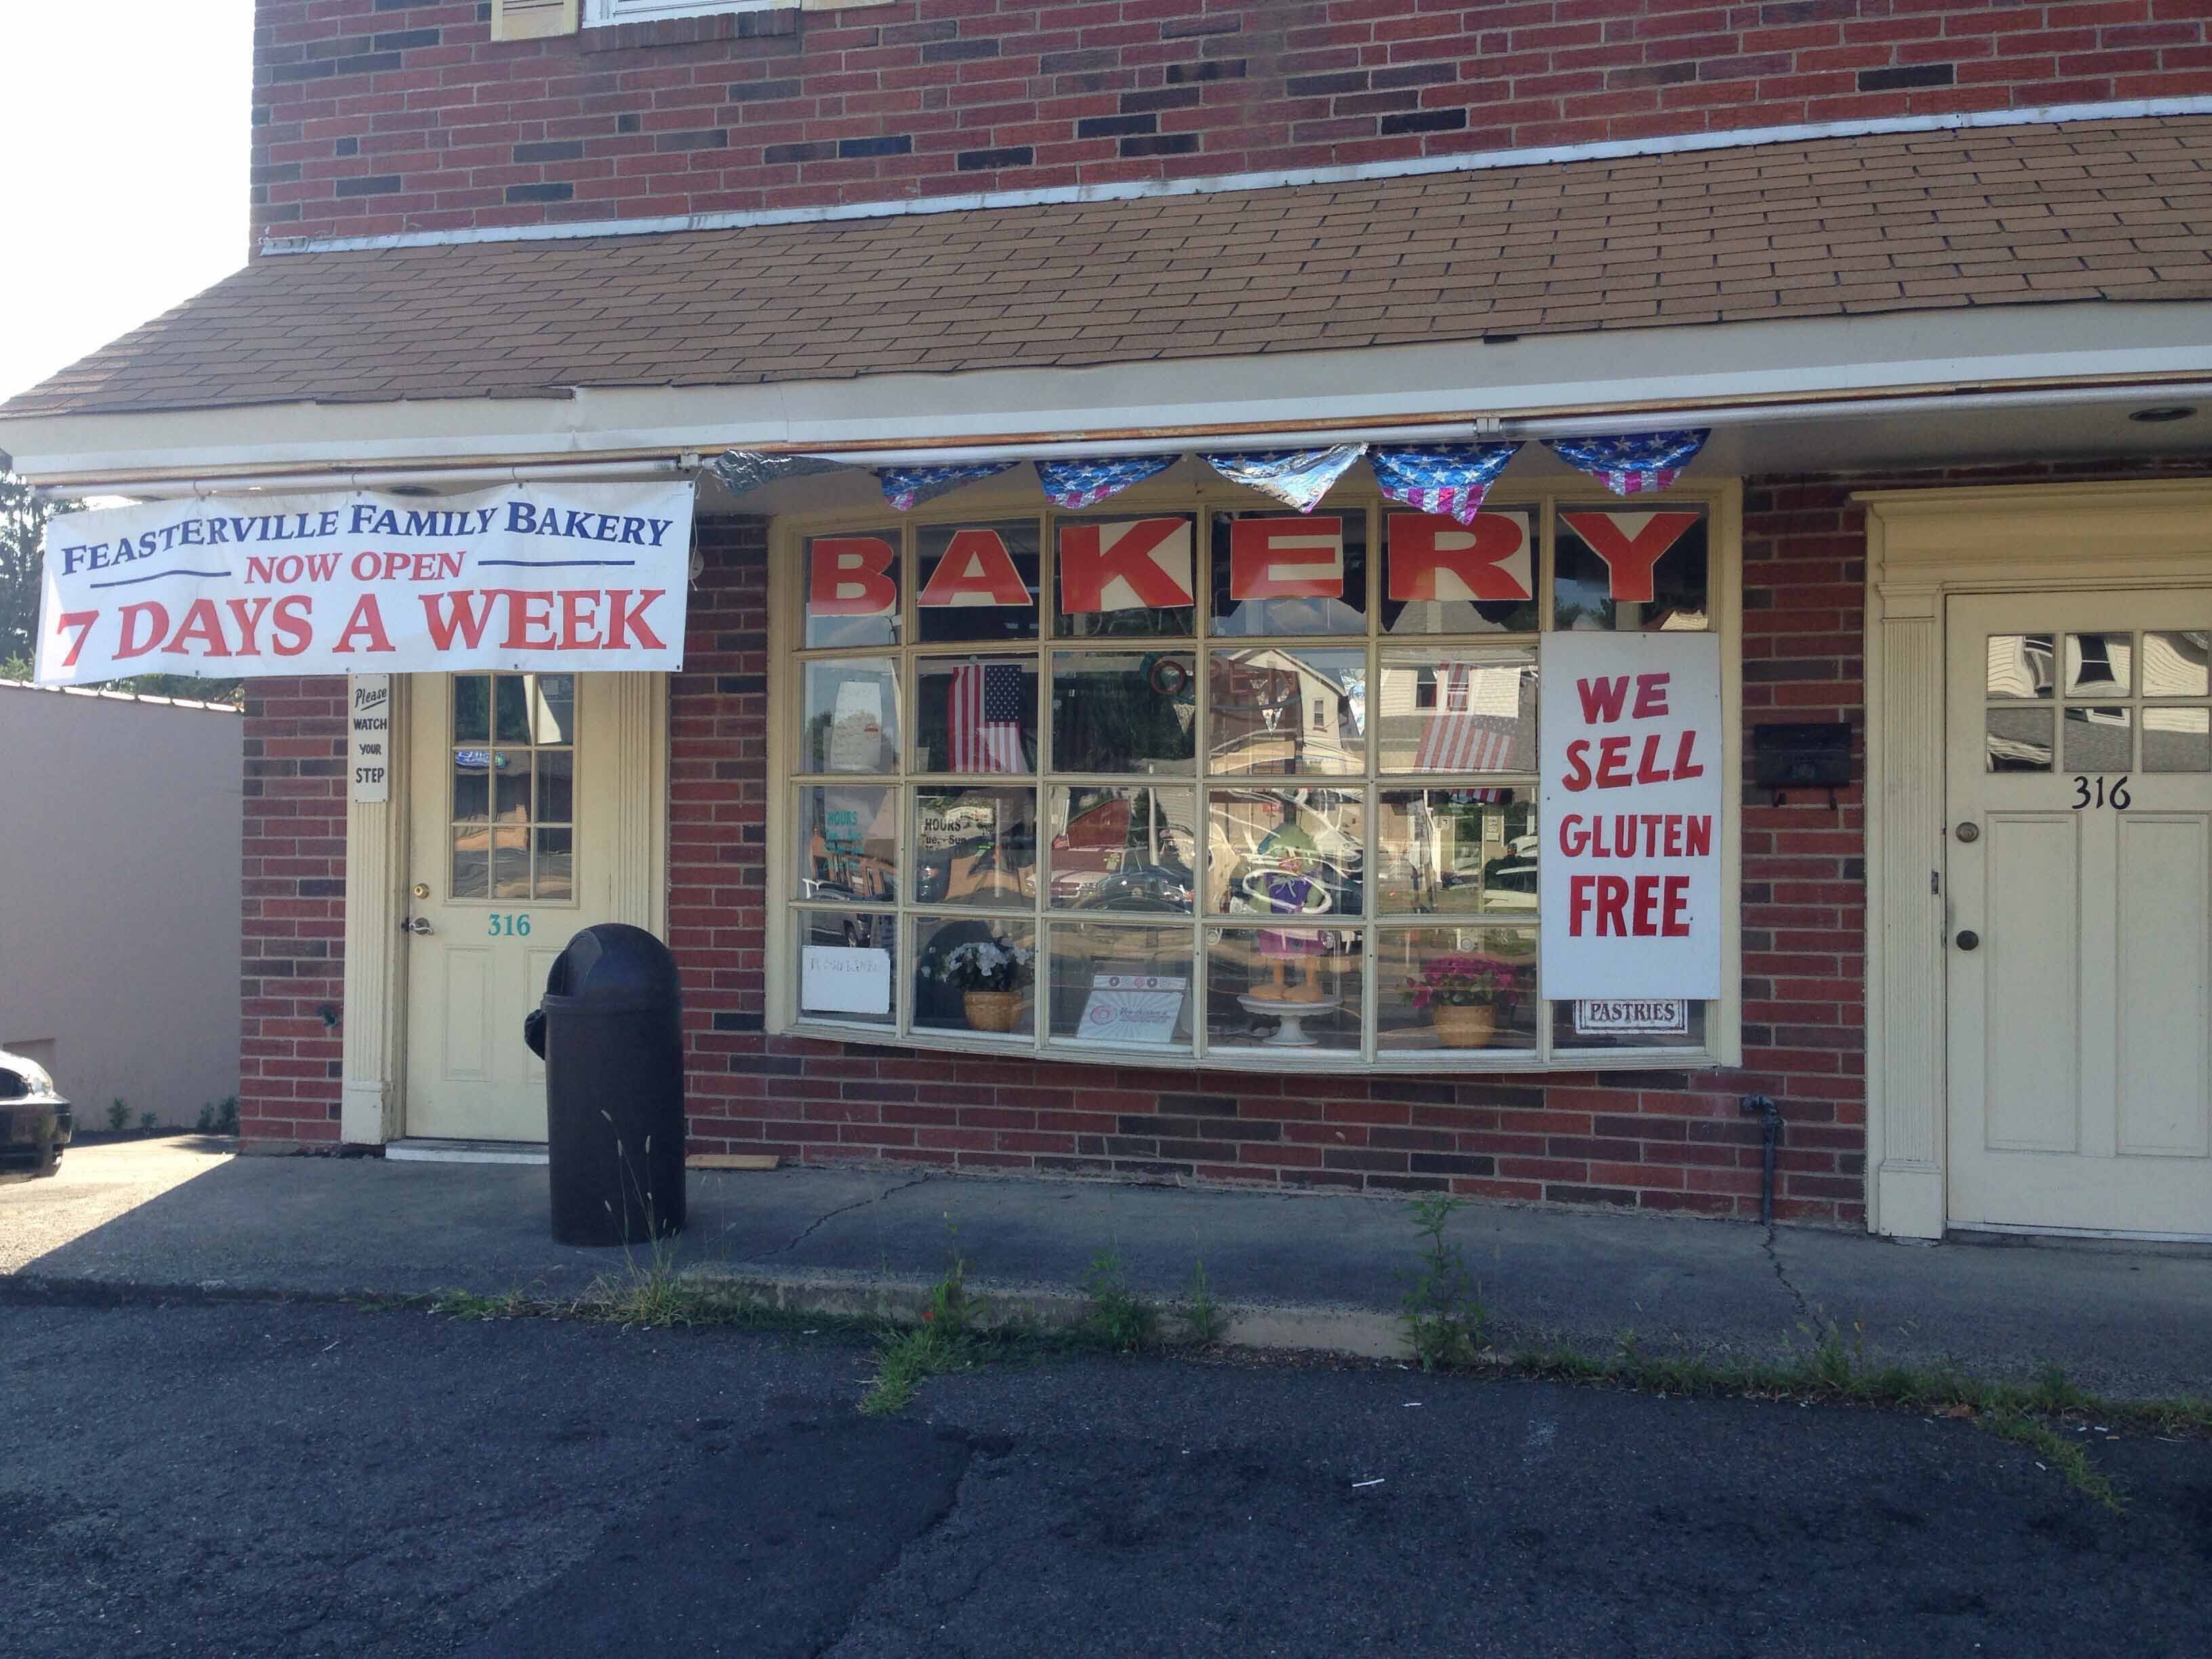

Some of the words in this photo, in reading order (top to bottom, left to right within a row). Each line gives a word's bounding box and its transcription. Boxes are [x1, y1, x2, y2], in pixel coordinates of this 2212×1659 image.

[60, 511, 340, 576] FEASTERVILLE
[348, 504, 498, 537] FAMILY
[504, 501, 674, 548] BAKERY
[244, 552, 343, 583] NOW
[351, 550, 467, 581] OPEN
[810, 512, 1700, 617] BAKERY
[56, 610, 100, 667] 7
[111, 594, 313, 661] DAYS
[331, 593, 396, 653] A
[417, 589, 667, 651] WEEK
[354, 688, 388, 708] Please
[1576, 672, 1671, 724] WE
[353, 718, 388, 731] WATCH
[359, 743, 382, 756] YOUR
[1561, 730, 1704, 792] SELL
[356, 767, 385, 783] STEP
[2071, 775, 2131, 811] 316
[827, 809, 857, 825] HOURS
[924, 818, 962, 832] HOURS
[1559, 813, 1712, 858] GLUTEN
[1569, 874, 1691, 938] FREE
[487, 914, 531, 937] 316
[1590, 1002, 1676, 1021] PASTRIES
